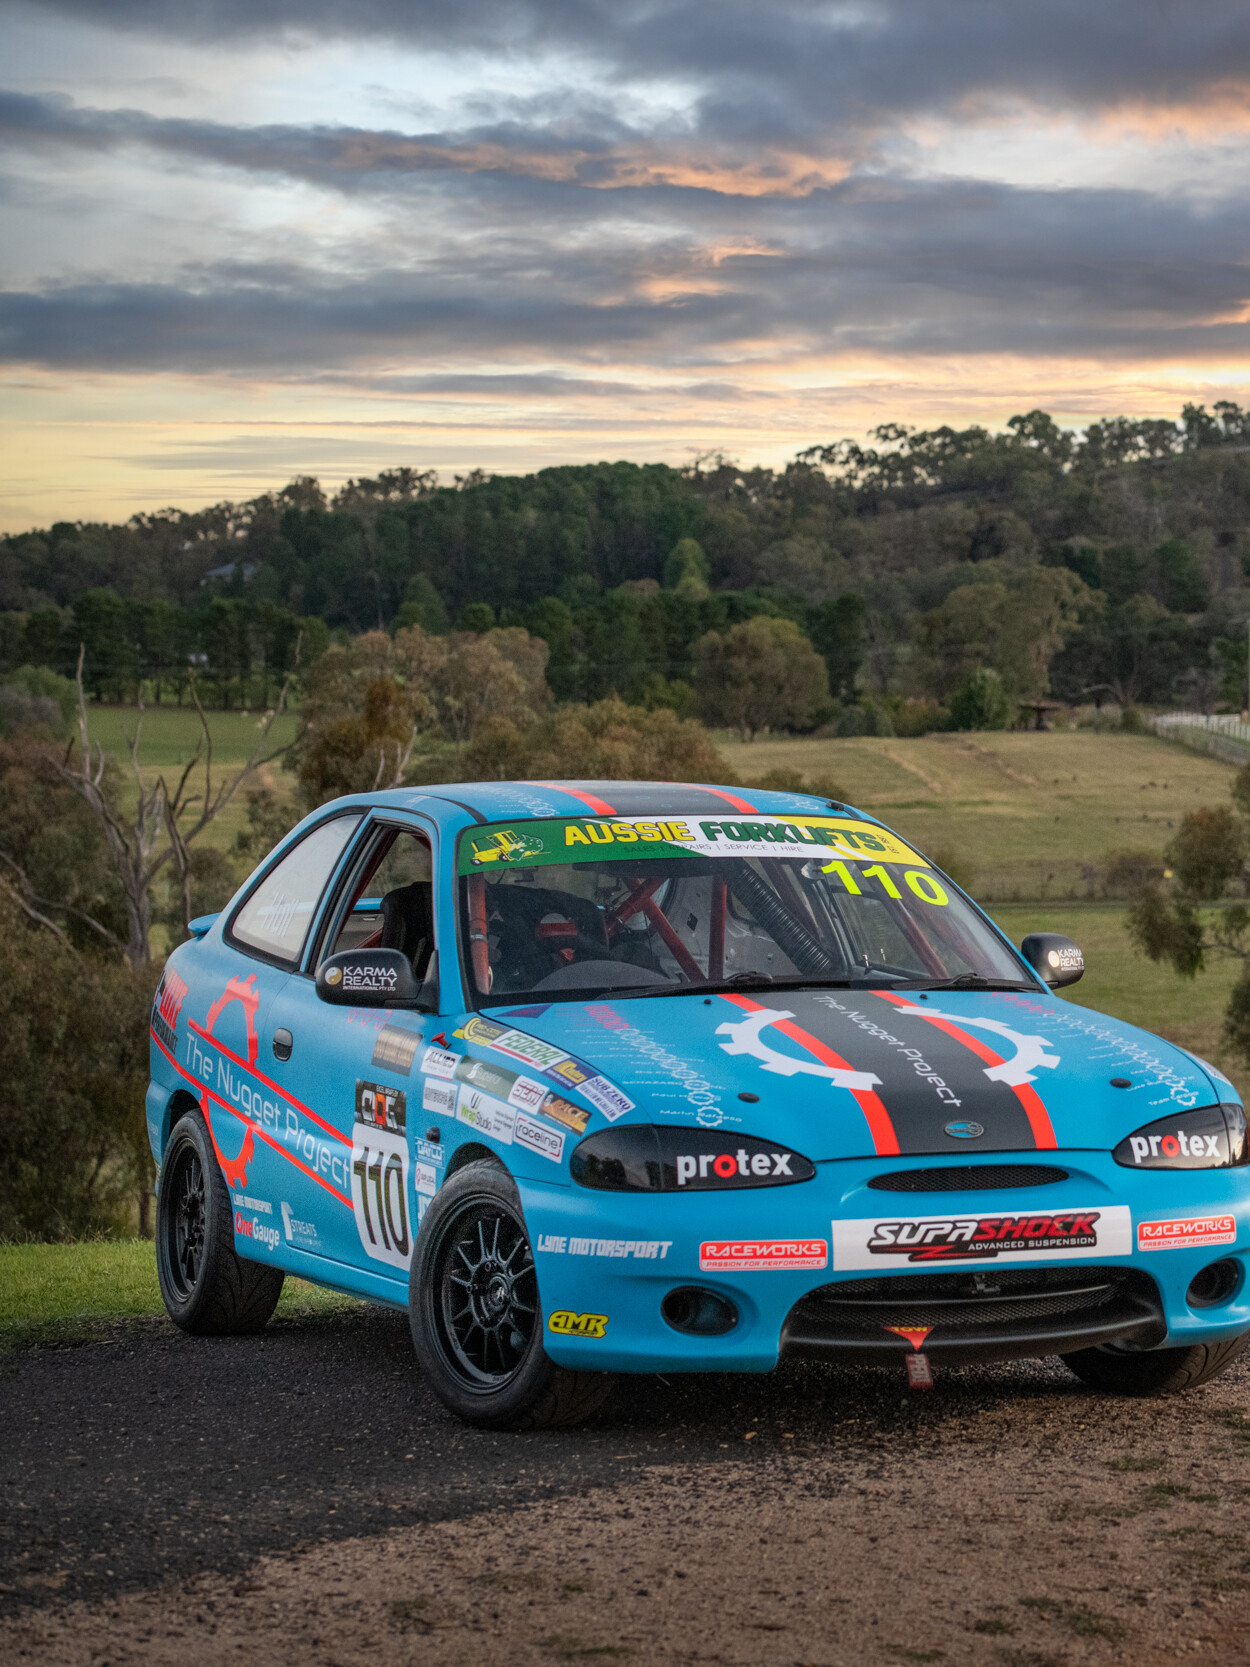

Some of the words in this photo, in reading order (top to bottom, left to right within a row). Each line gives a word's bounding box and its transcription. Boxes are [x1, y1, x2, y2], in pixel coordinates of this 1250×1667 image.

[564, 821, 696, 847] AUSSIE
[698, 821, 887, 853] FORKLIFTS
[723, 843, 768, 851] SERVICE
[821, 859, 949, 906] 110
[343, 966, 398, 977] KARMA
[343, 976, 398, 987] REALTY
[497, 1033, 564, 1066] FEDERAL
[813, 995, 846, 1011] The
[840, 1010, 906, 1047] Nugget
[897, 1048, 962, 1108] Project
[186, 1032, 213, 1081] The
[217, 1057, 281, 1132] Nugget
[284, 1108, 349, 1189] Project
[606, 1088, 632, 1112] ZERO
[518, 1124, 558, 1150] raceline
[1129, 1130, 1221, 1164] protex
[676, 1148, 794, 1186] protex
[353, 1145, 410, 1257] 110
[235, 1211, 280, 1251] OneGauge
[869, 1212, 1100, 1246] SUPASHOCK
[1142, 1218, 1232, 1238] RACEWORKS
[1143, 1239, 1172, 1248] PASSION
[1187, 1233, 1232, 1243] PERFORMANCE
[568, 1237, 673, 1260] MOTORSPORT
[705, 1242, 822, 1257] RACEWORKS
[967, 1239, 1025, 1251] ADVANCED
[1028, 1236, 1095, 1248] SUSPENSION
[706, 1259, 742, 1267] PASSION
[743, 1259, 761, 1267] FOR
[762, 1258, 822, 1267] PERFORMANCE
